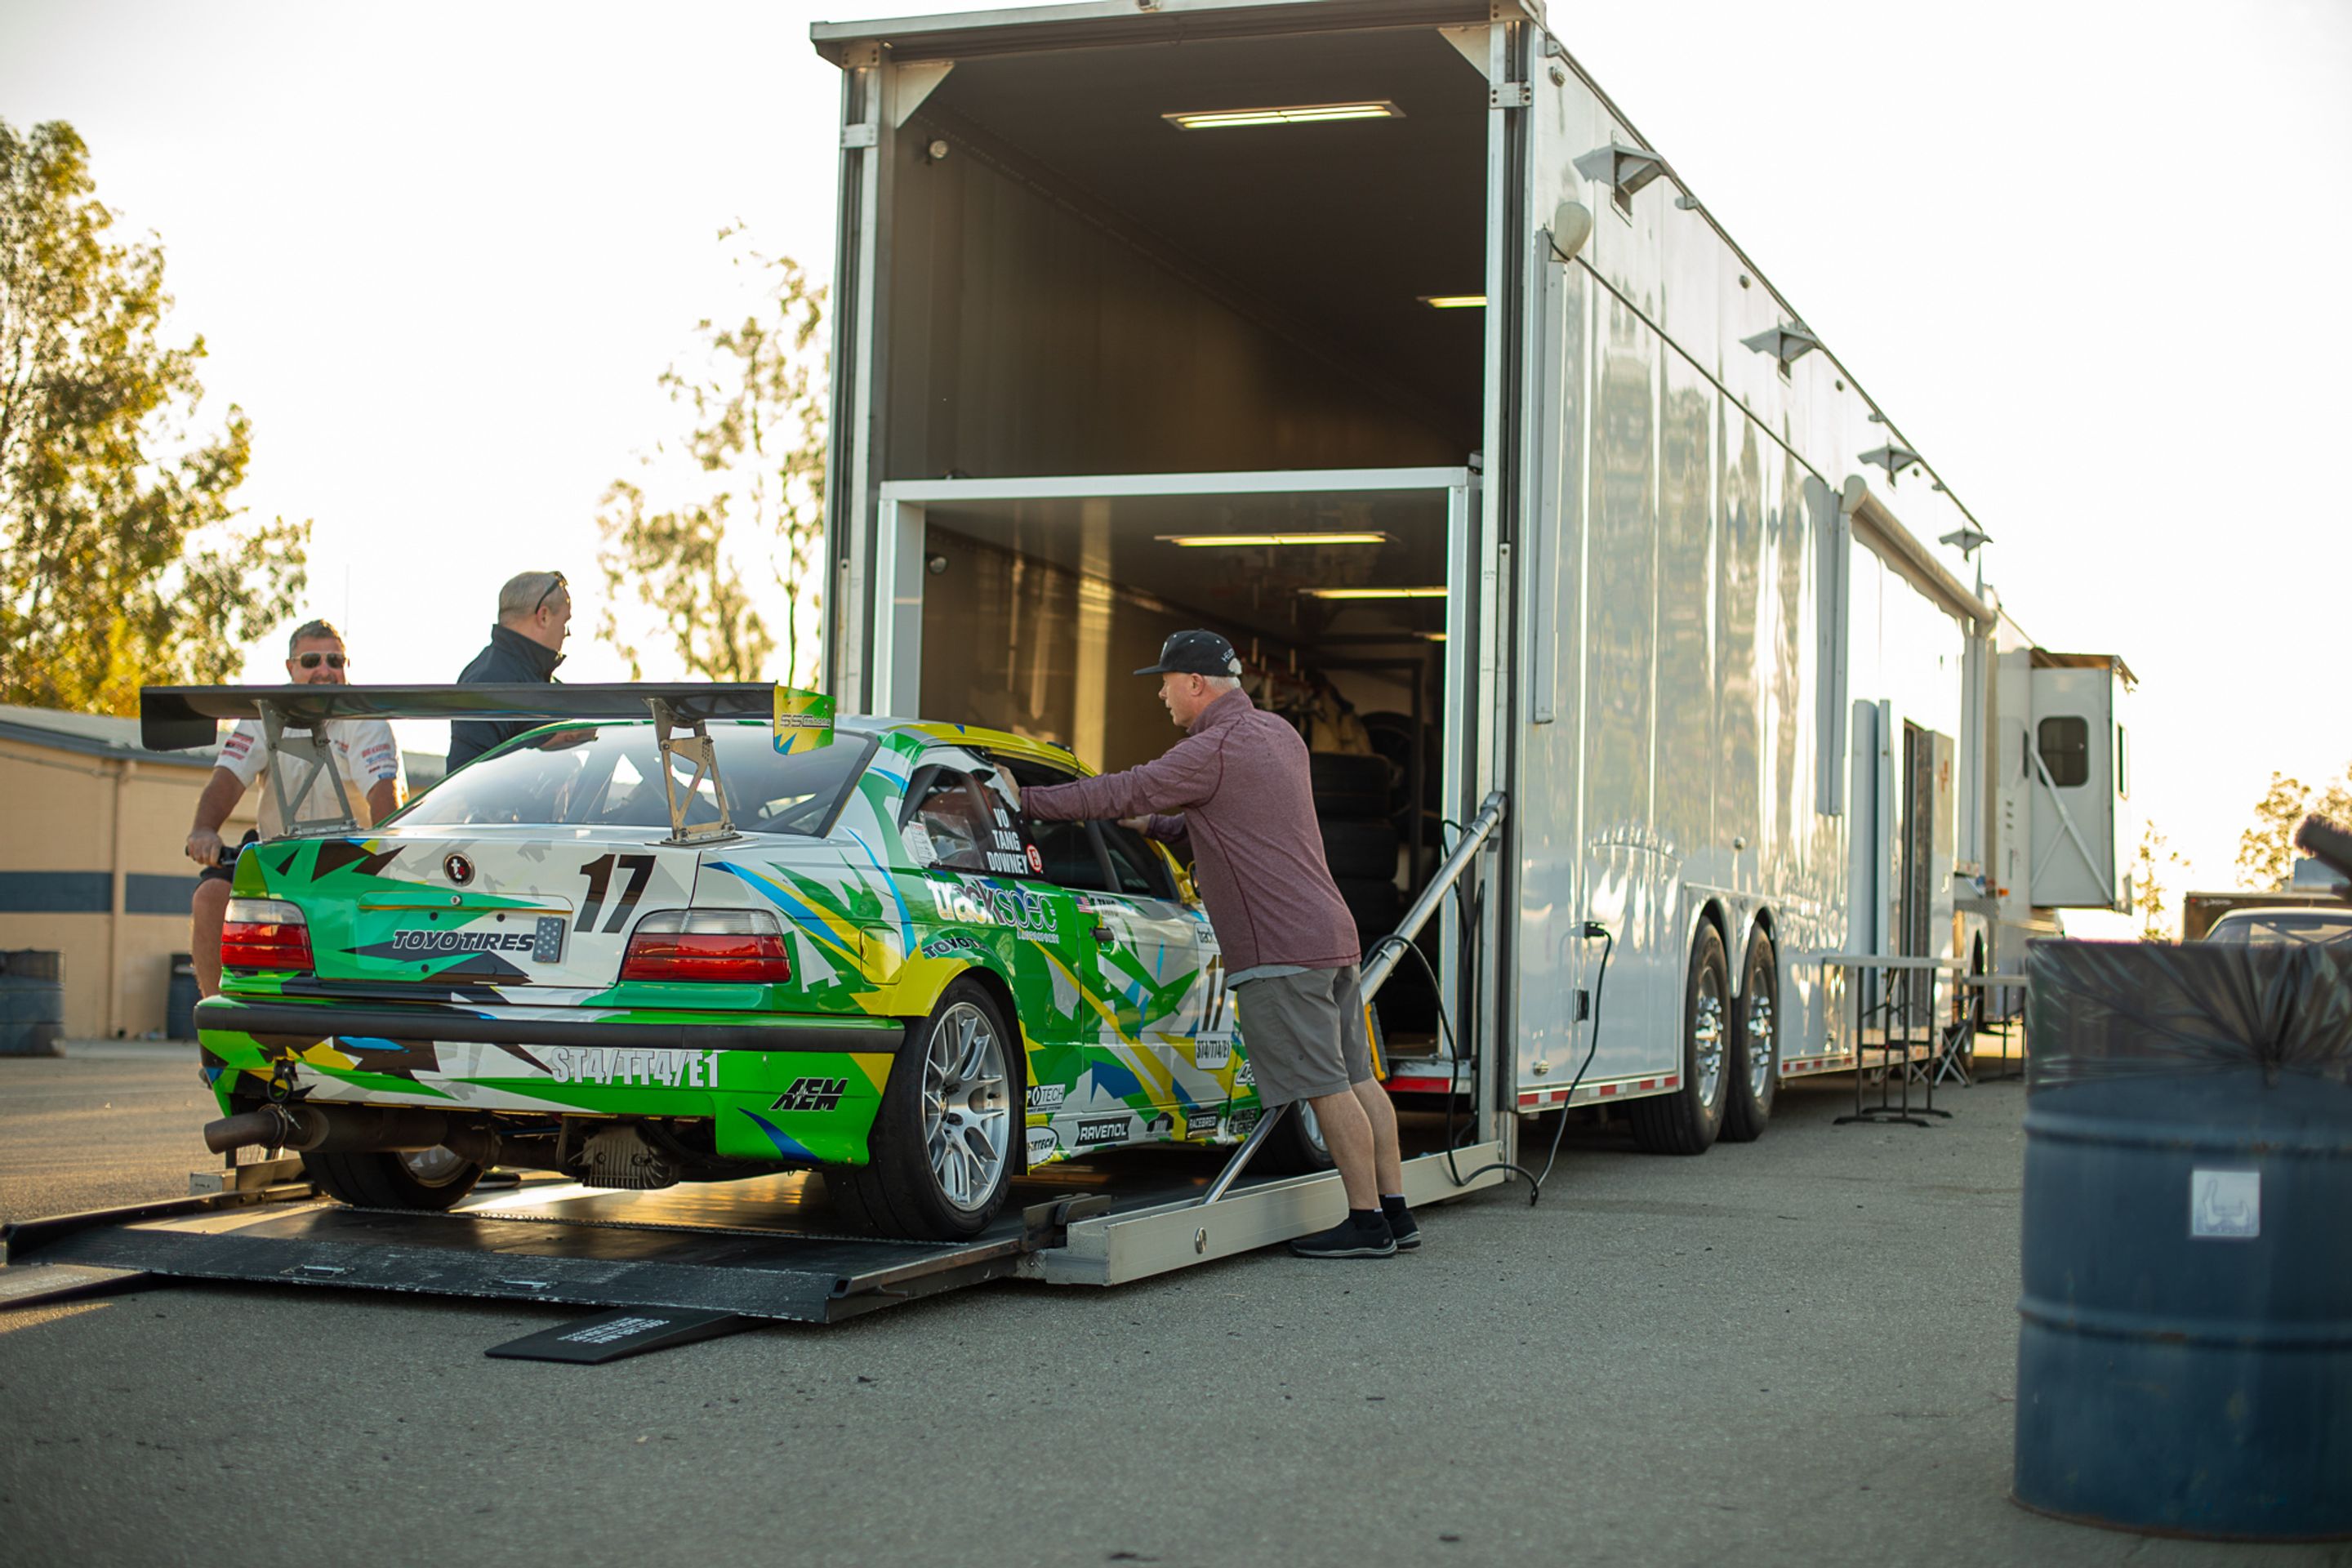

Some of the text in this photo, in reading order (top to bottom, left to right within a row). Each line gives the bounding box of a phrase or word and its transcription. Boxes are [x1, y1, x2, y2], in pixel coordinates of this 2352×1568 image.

[993, 808, 1009, 827] VO
[991, 830, 1020, 851] TANG
[987, 852, 1029, 875] DOWNEY
[573, 853, 657, 933] 17
[551, 1046, 719, 1088] ST4/TT4/E1
[1080, 1123, 1128, 1141] RAVENOL
